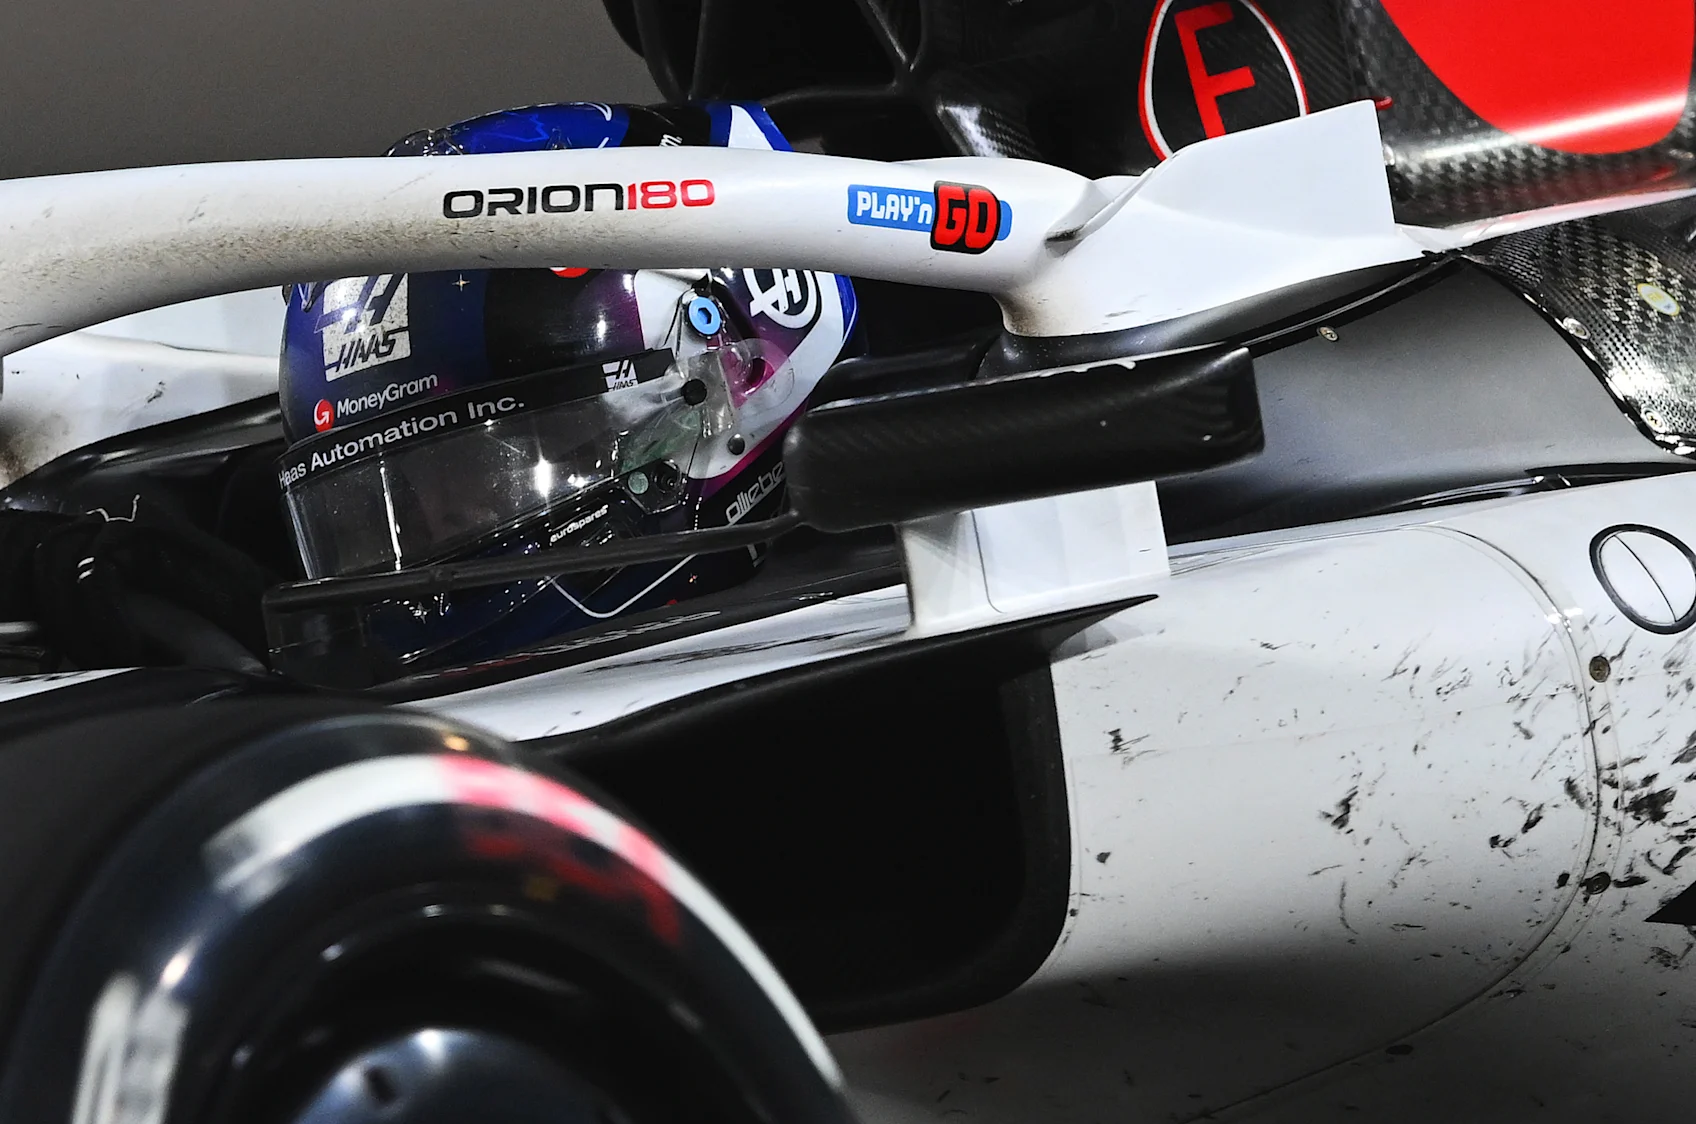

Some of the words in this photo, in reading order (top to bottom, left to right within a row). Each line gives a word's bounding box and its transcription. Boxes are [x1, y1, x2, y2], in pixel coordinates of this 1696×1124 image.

[443, 179, 715, 219] ORION180
[934, 184, 998, 249] GO
[326, 327, 409, 374] HAAS
[336, 373, 438, 418] MoneyGram
[278, 461, 307, 490] Haas
[311, 409, 458, 471] Automation
[468, 396, 525, 420] Inc.
[549, 504, 609, 544] eurospares
